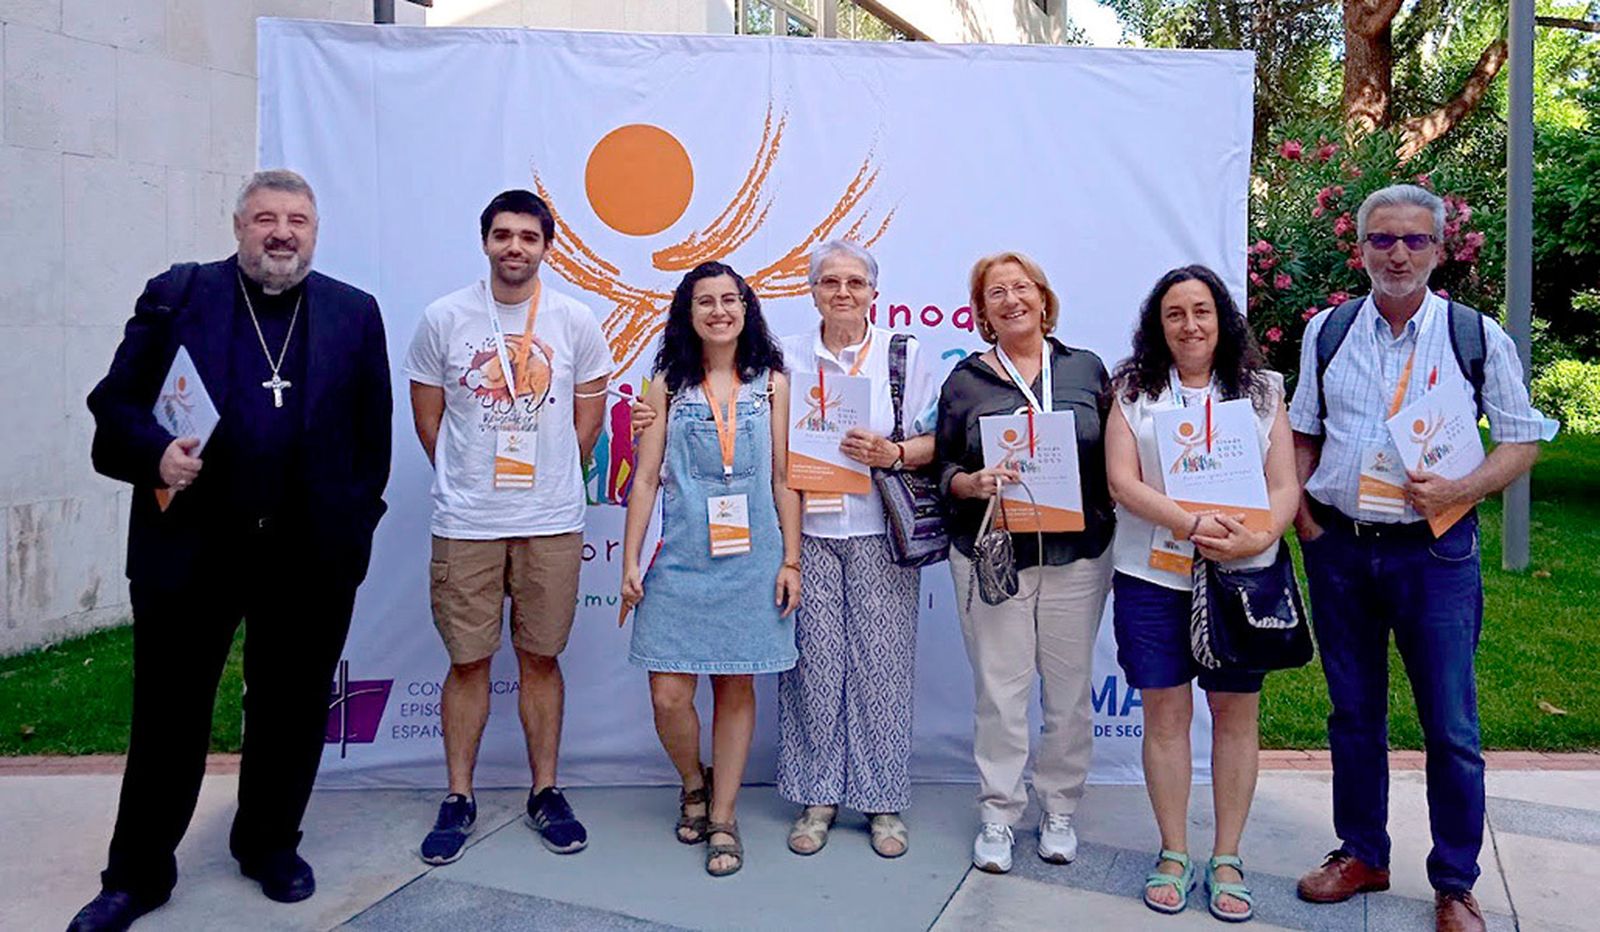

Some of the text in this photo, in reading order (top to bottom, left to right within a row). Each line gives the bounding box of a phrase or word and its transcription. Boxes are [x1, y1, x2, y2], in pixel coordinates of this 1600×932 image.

[581, 540, 620, 561] or
[407, 681, 520, 696] CONCIA
[1091, 675, 1142, 716] MA
[392, 722, 445, 739] ESPAÑ
[1094, 725, 1112, 737] DE
